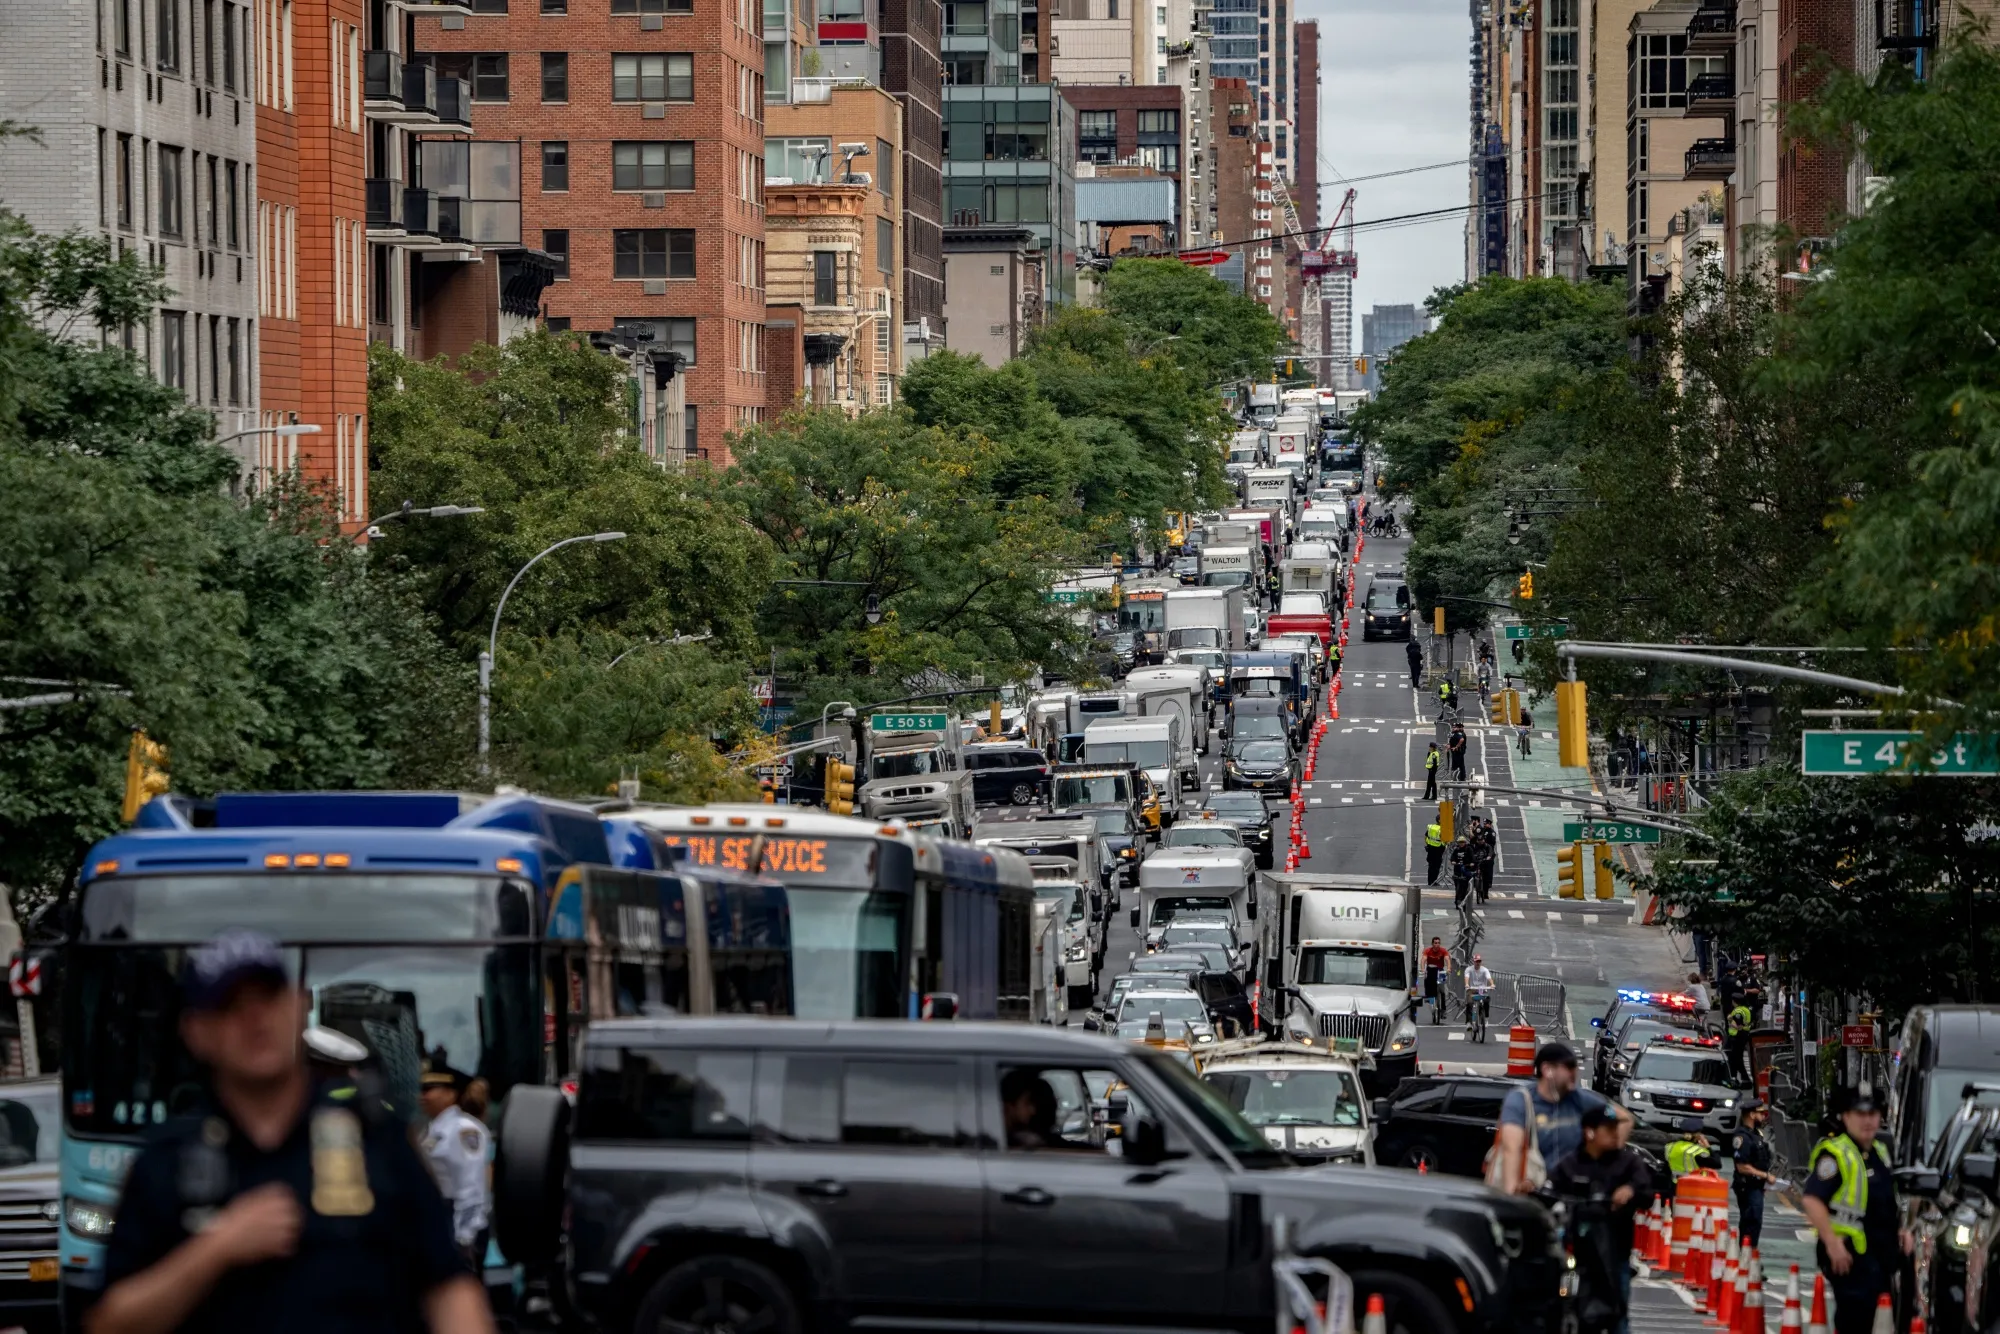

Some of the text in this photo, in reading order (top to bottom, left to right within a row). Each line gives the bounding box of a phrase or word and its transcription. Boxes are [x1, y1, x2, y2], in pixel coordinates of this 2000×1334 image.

[1518, 628, 1524, 636] E
[885, 718, 933, 728] E 50 St
[1843, 741, 1862, 765] E
[1581, 827, 1641, 839] E 49 St
[1331, 906, 1379, 920] UNFI
